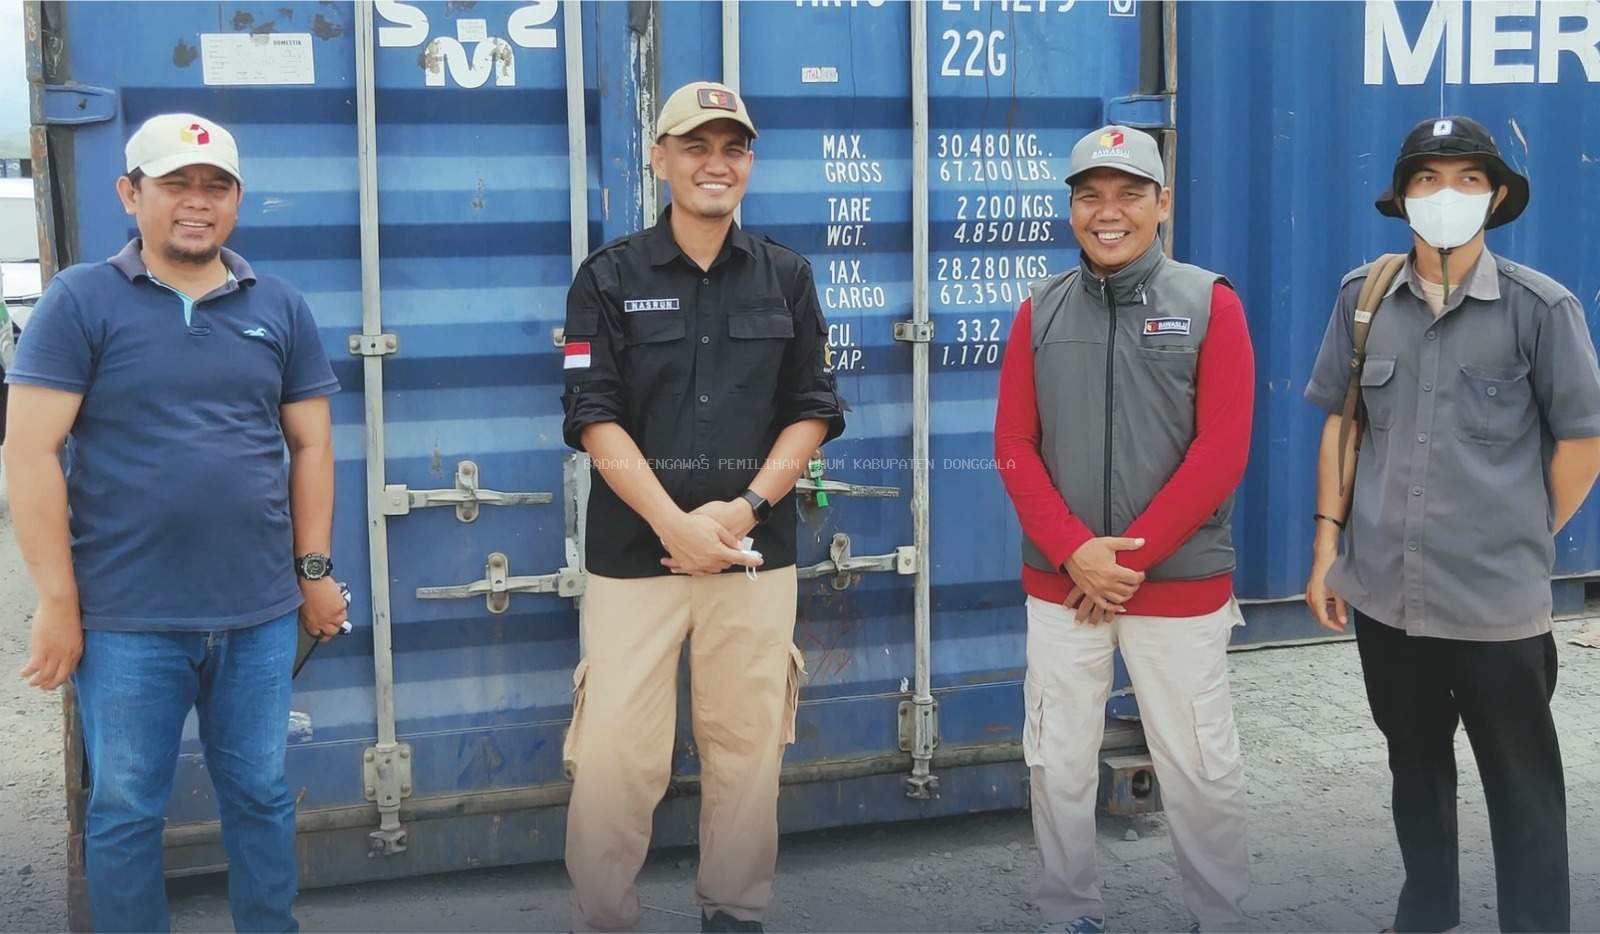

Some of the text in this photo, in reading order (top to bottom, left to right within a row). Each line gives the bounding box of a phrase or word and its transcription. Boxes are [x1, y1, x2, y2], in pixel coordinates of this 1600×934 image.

[941, 29, 1007, 77] 22G
[823, 134, 866, 159] MAX.
[825, 161, 882, 183] GROSS
[1017, 159, 1057, 181] LBS.
[828, 197, 872, 222] TARE
[1021, 194, 1059, 219] KGS.
[827, 224, 866, 246] WGT.
[1017, 220, 1055, 242] LBS.
[1015, 255, 1053, 279] KGS.
[825, 286, 886, 309] CARGO
[828, 323, 856, 348] CU.
[956, 318, 1001, 342] 33.2
